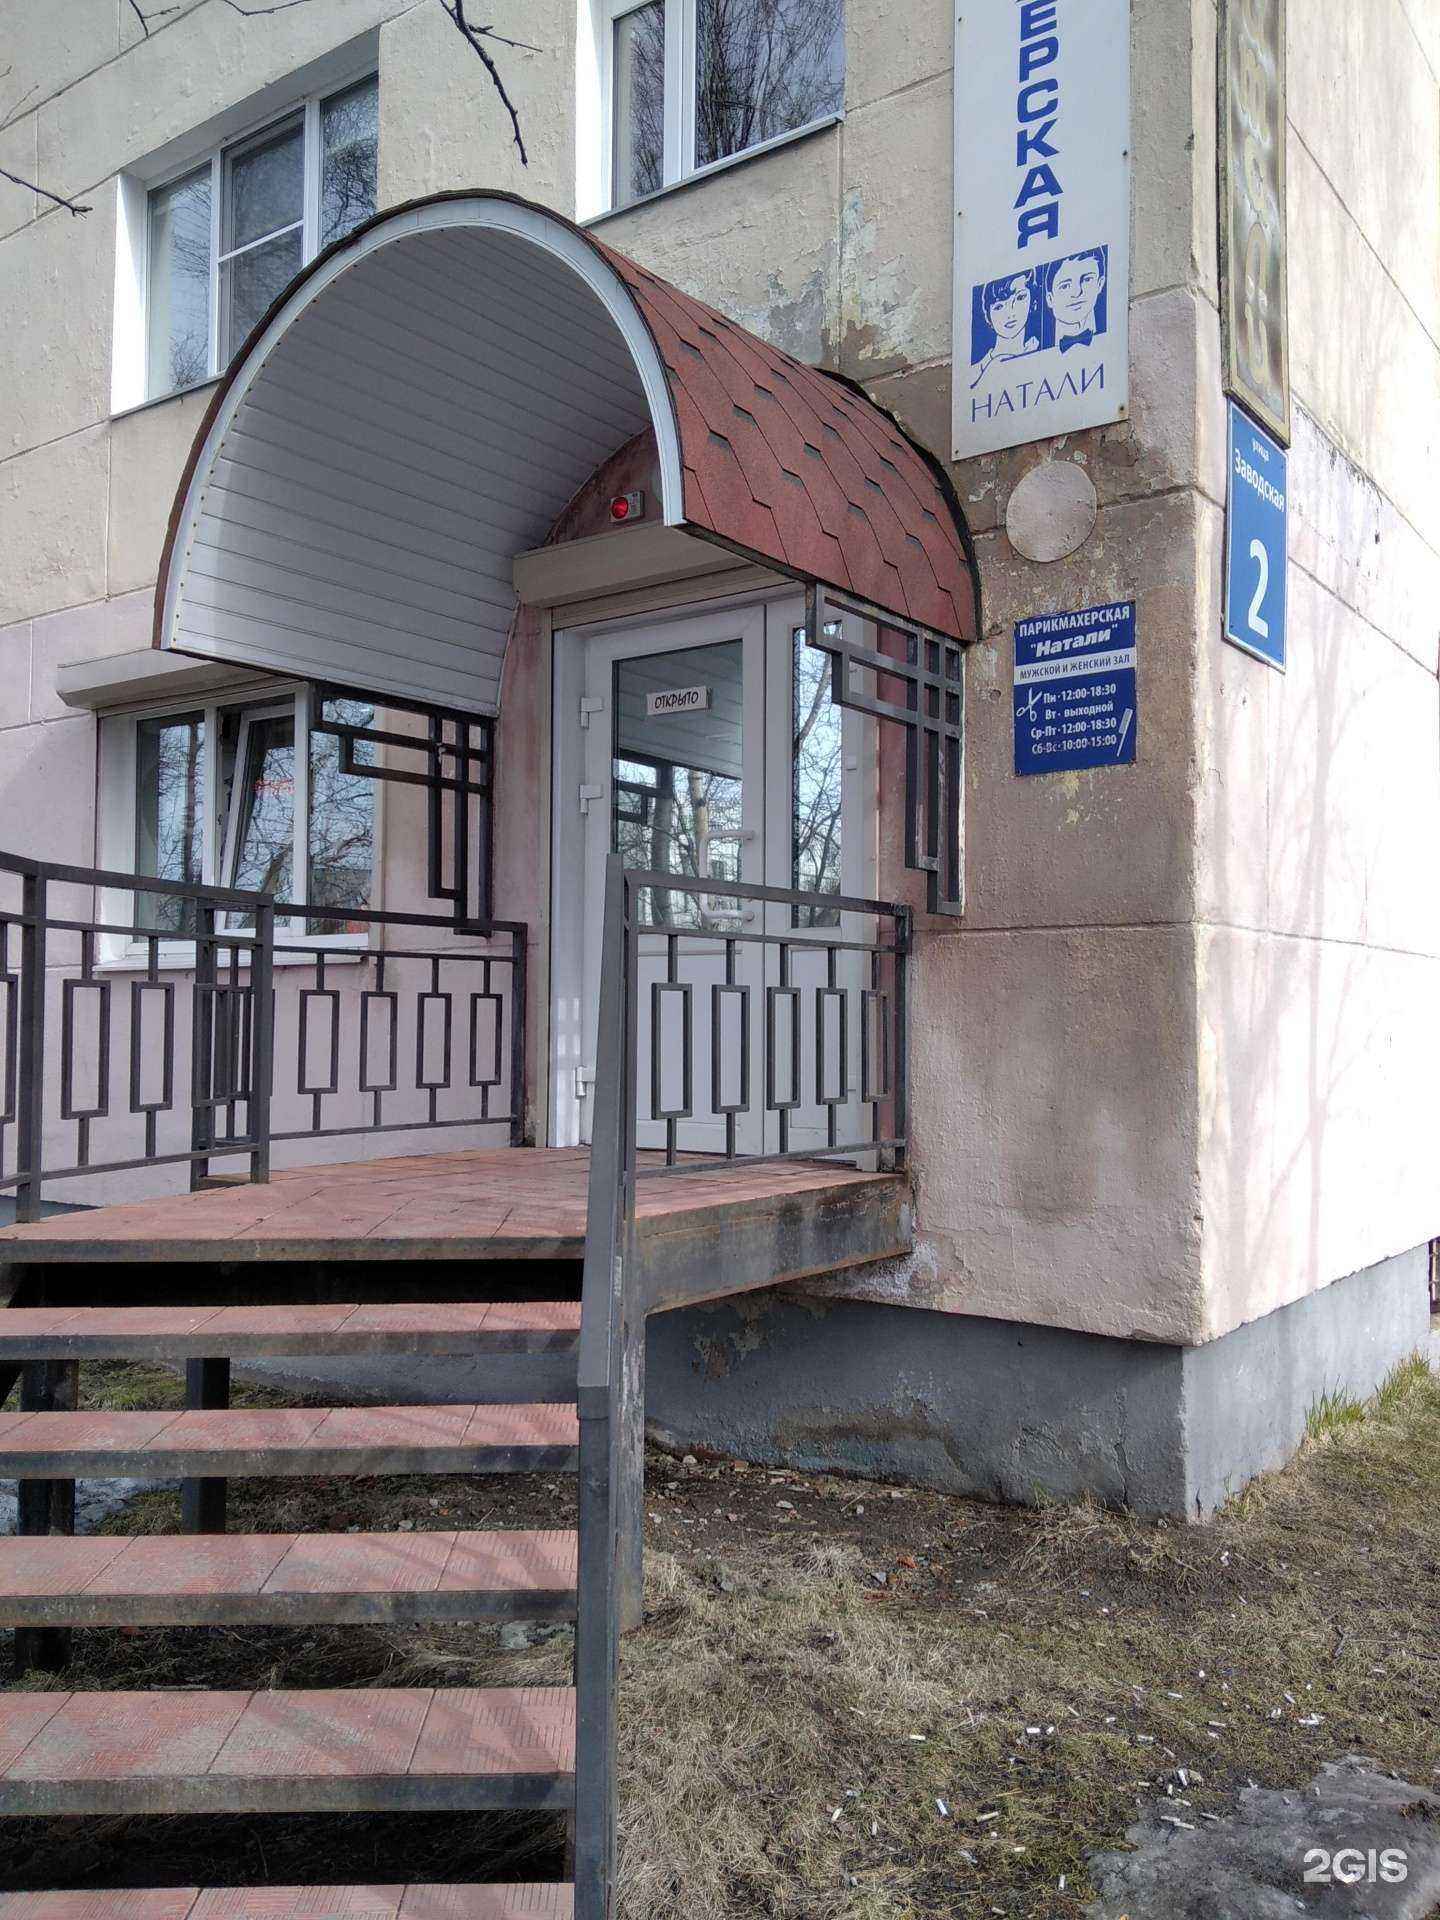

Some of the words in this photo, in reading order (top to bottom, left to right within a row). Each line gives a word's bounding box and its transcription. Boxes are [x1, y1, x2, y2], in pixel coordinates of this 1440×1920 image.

[1013, 0, 1063, 249] ЕРСКАЯ
[971, 363, 1104, 422] НАТАЛИ
[1234, 448, 1285, 513] Заводская
[1248, 539, 1269, 638] 2
[1019, 605, 1130, 638] ПАРИКМАХЕРСКАЯ
[1030, 624, 1118, 658] "Натали"
[1020, 663, 1061, 679] МУЖСКОЙ
[1063, 662, 1069, 673] И
[1070, 656, 1112, 672] ЖЕНСКИЙ
[1113, 654, 1130, 665] ЗАЛ
[654, 691, 699, 710] ОТКРЫТО
[1064, 700, 1114, 718] выходной
